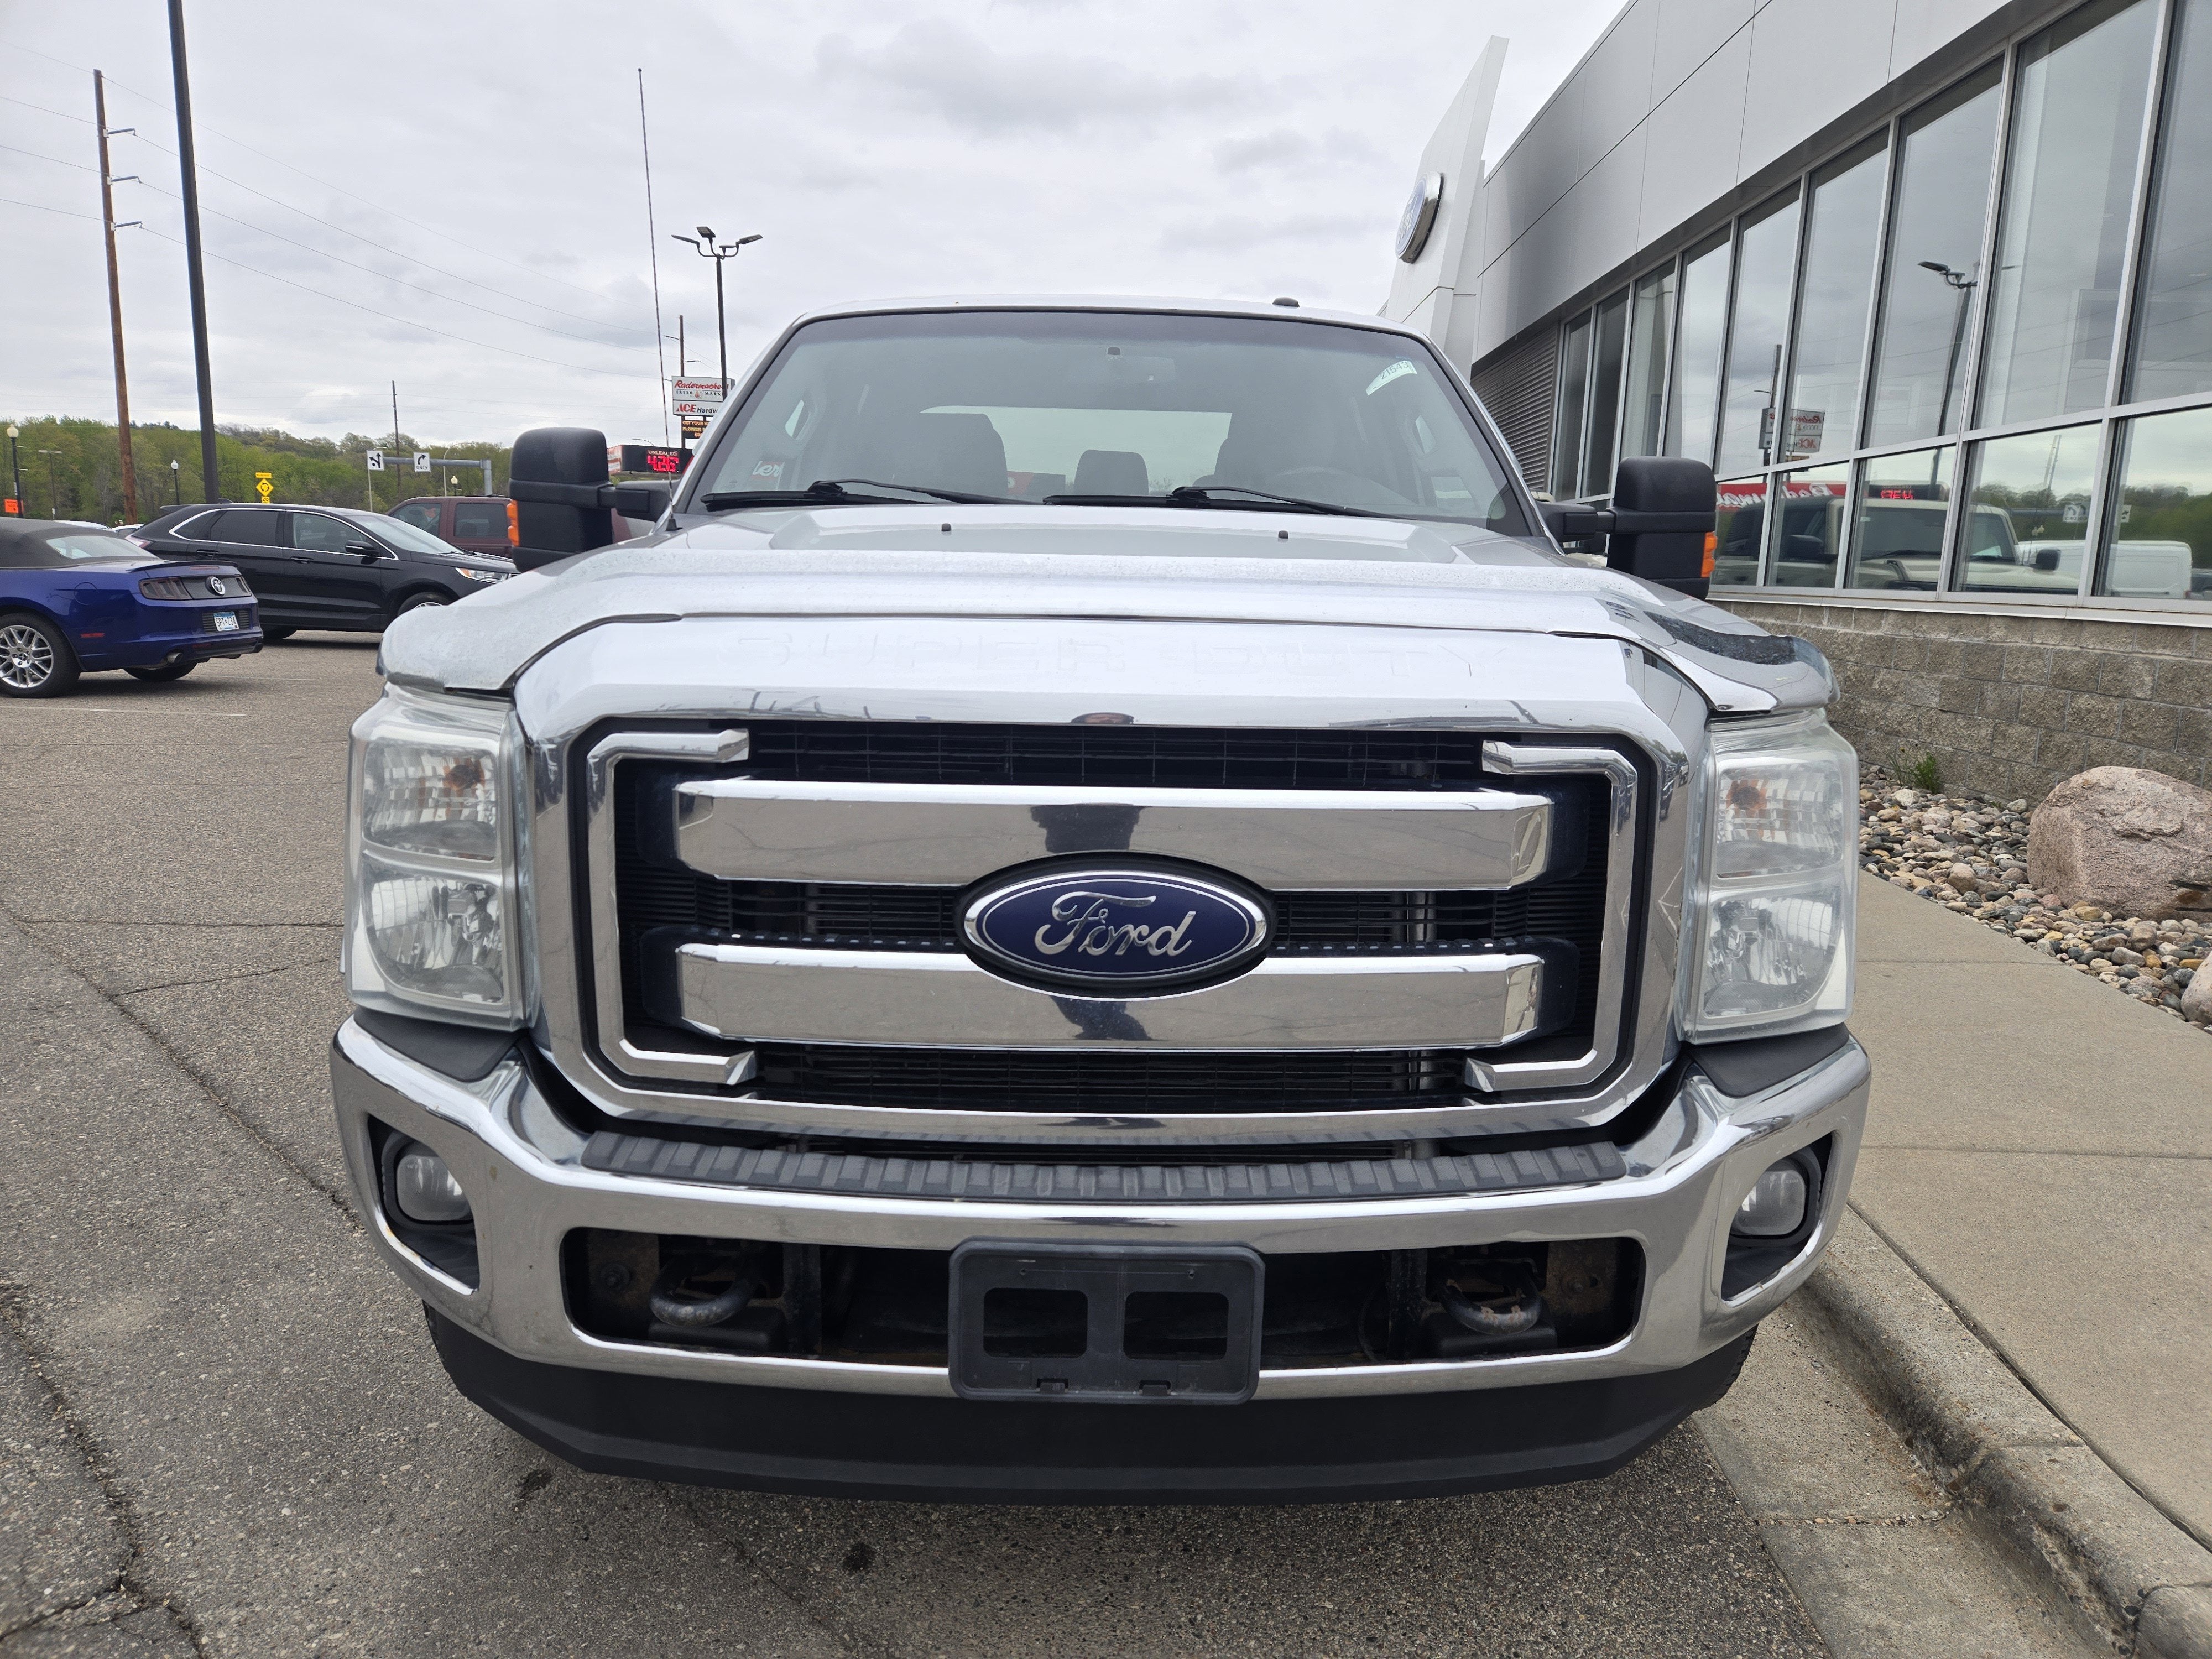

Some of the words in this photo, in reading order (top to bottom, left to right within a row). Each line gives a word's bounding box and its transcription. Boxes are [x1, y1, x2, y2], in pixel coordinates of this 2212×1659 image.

[1380, 361, 1409, 379] 21543
[675, 380, 729, 389] Radermache
[676, 403, 696, 413] ACE
[716, 632, 1126, 673] SUPER
[1191, 638, 1509, 679] DUTY
[1035, 891, 1196, 957] Ford
